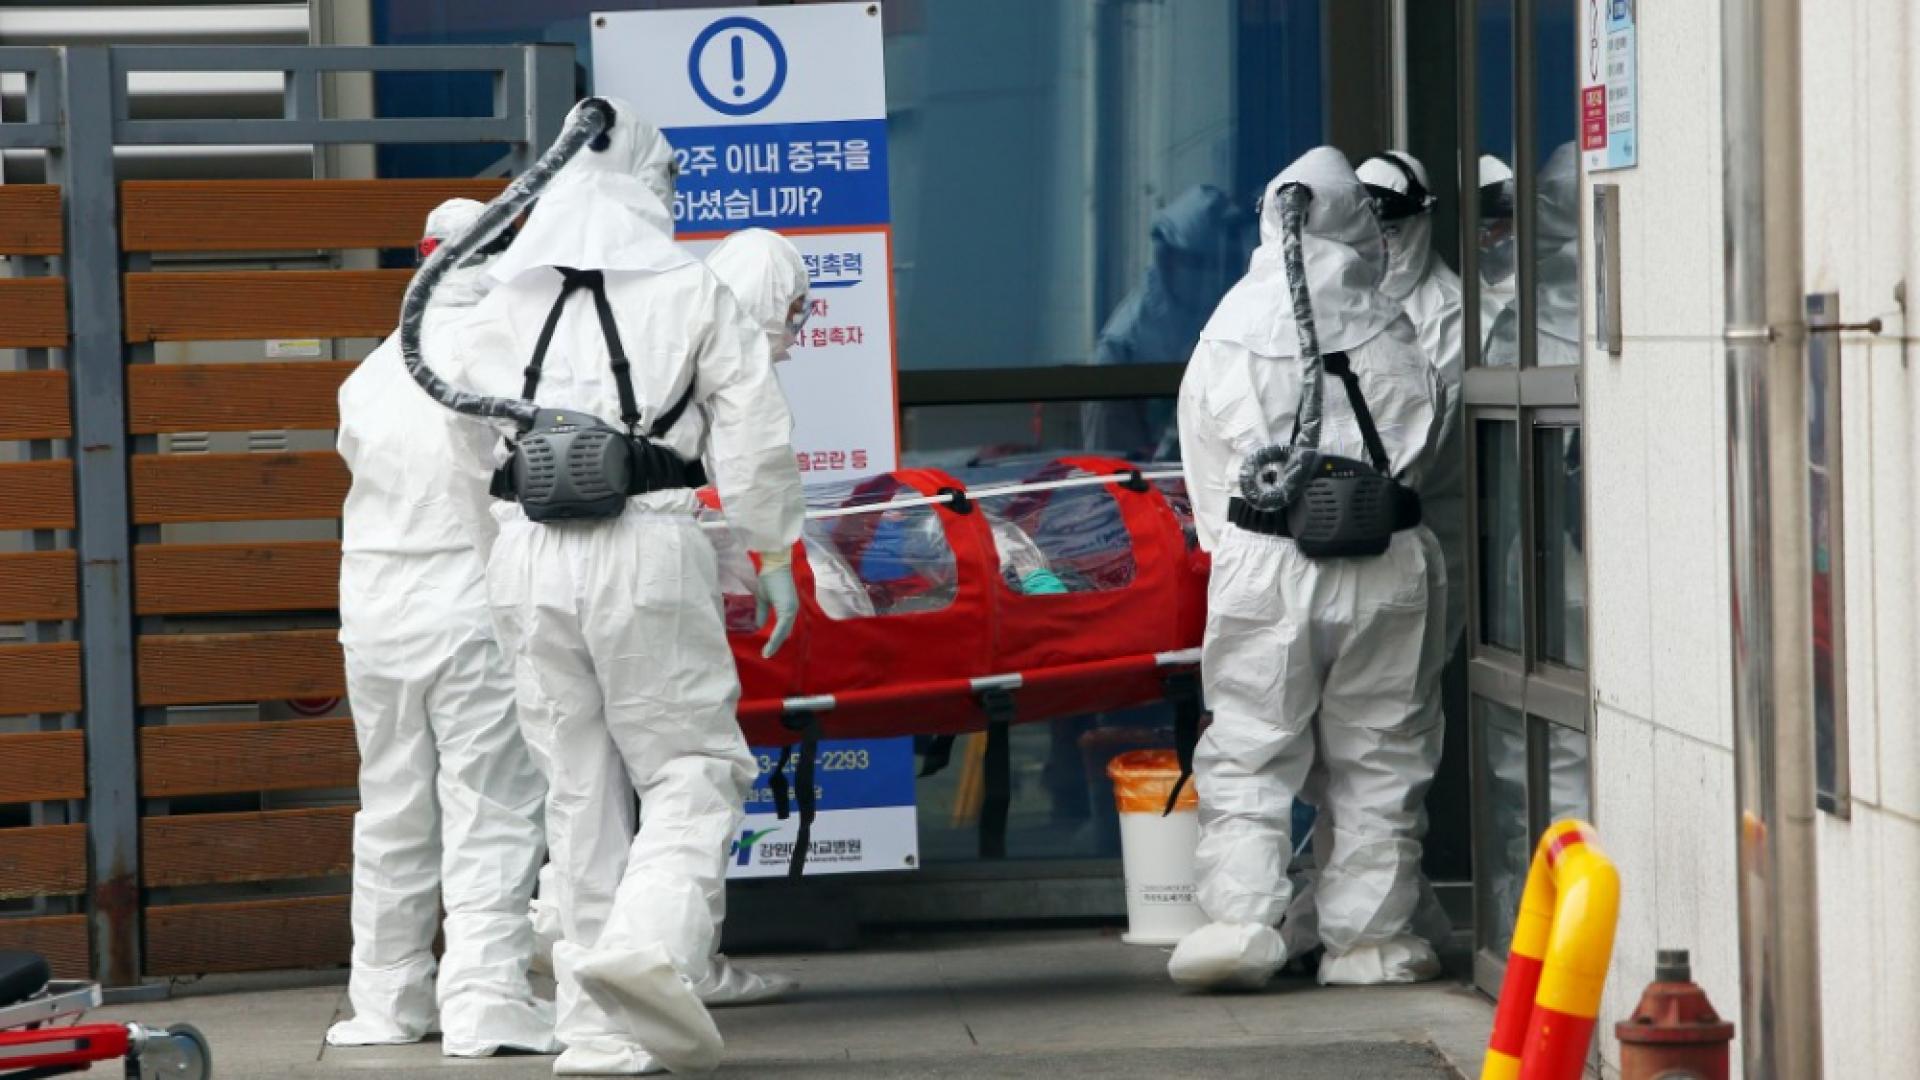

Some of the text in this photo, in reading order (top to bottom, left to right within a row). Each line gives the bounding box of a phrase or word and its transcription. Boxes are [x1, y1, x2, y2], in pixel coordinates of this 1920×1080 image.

[675, 139, 871, 177] 2주 이내 중국을
[673, 185, 823, 222] 하셨습니까?
